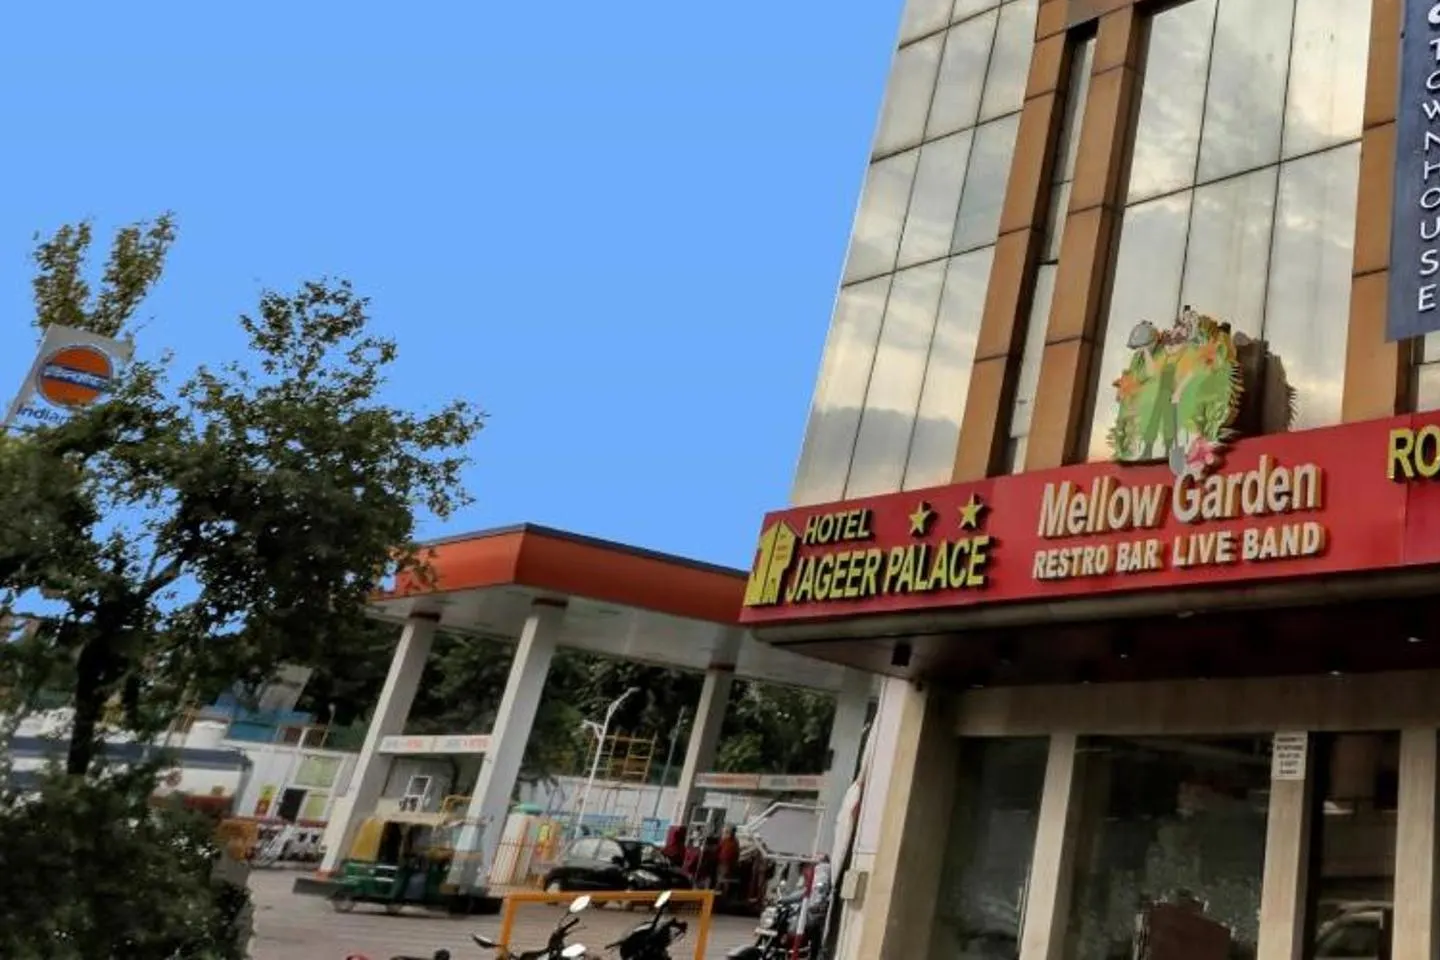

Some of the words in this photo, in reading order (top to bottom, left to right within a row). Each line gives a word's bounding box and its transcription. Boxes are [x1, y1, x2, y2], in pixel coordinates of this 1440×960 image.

[802, 507, 872, 545] HOTEL
[1037, 473, 1168, 540] Mellow
[1172, 453, 1322, 525] Garden
[784, 547, 883, 603] JAGEER
[883, 534, 991, 593] PALACE
[1032, 542, 1111, 581] RESTRO
[1115, 538, 1163, 573] BAR
[1171, 529, 1237, 568] LIVE
[1241, 520, 1325, 561] BAND
